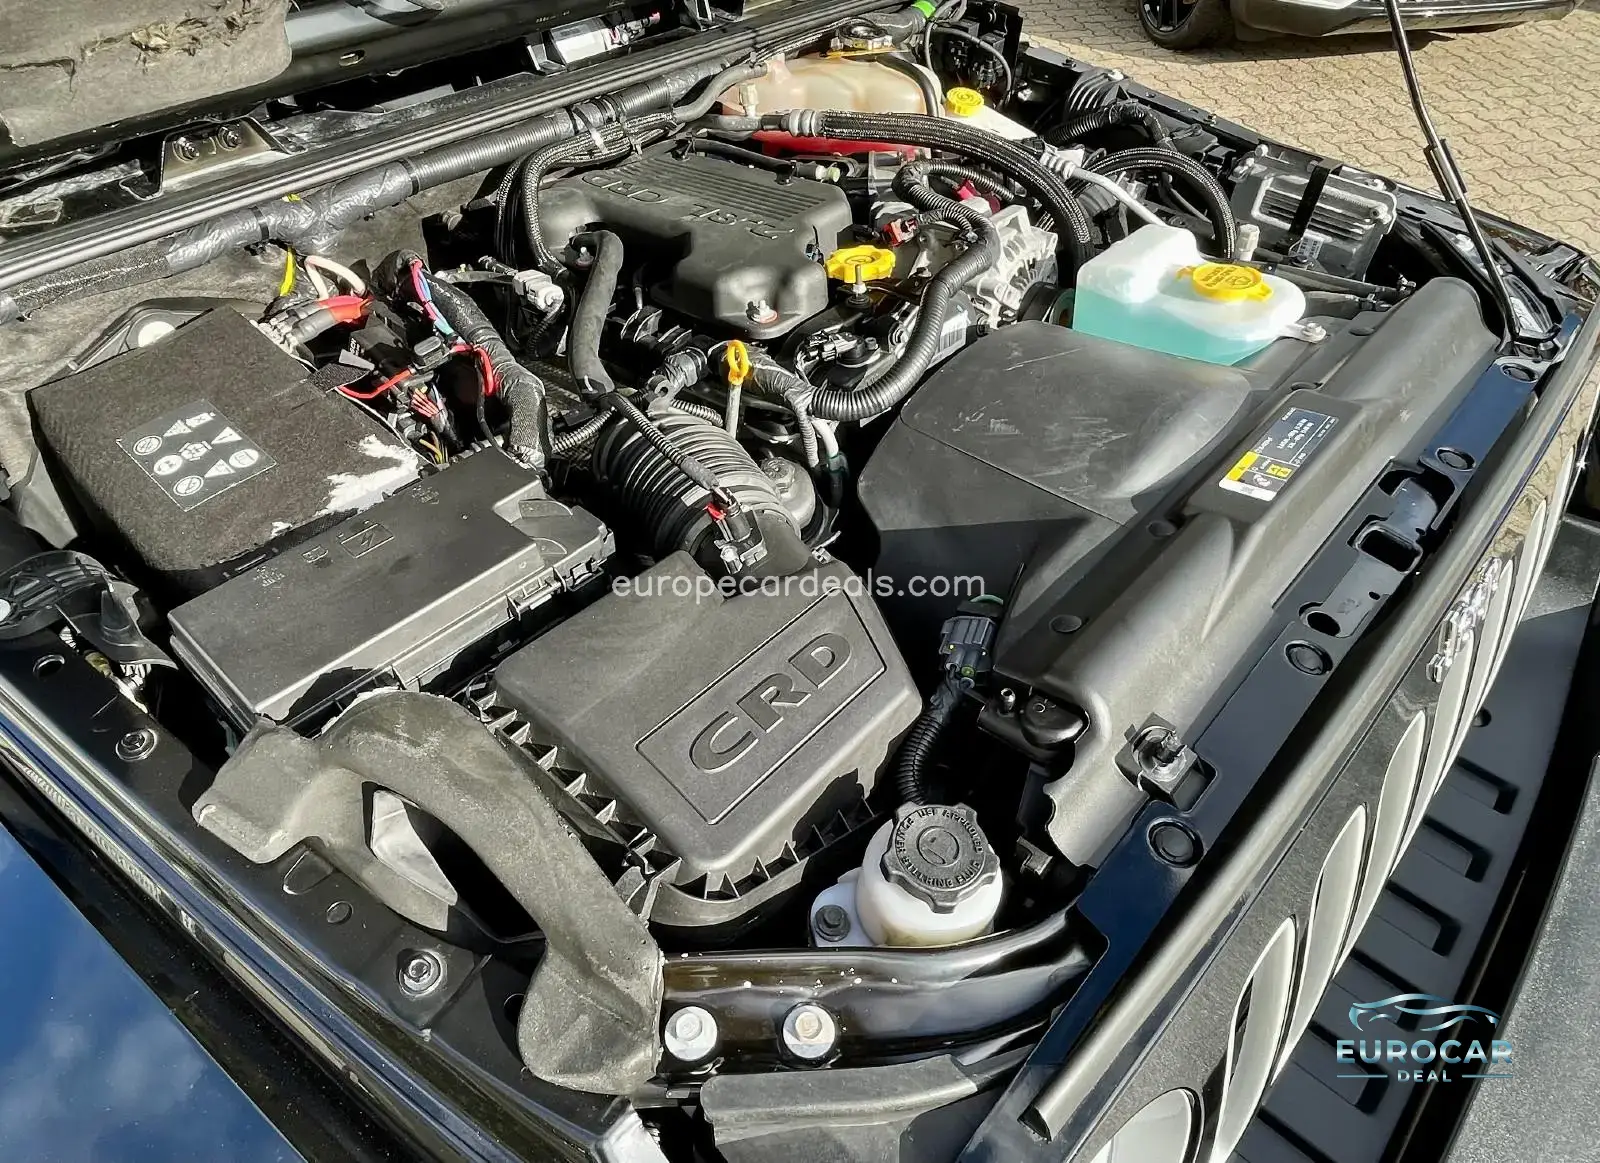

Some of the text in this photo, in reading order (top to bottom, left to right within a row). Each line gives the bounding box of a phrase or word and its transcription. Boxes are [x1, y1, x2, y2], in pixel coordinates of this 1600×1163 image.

[581, 174, 670, 203] CRD
[689, 632, 851, 774] CRD
[942, 809, 983, 854] APPROVED
[954, 860, 982, 886] FLUID
